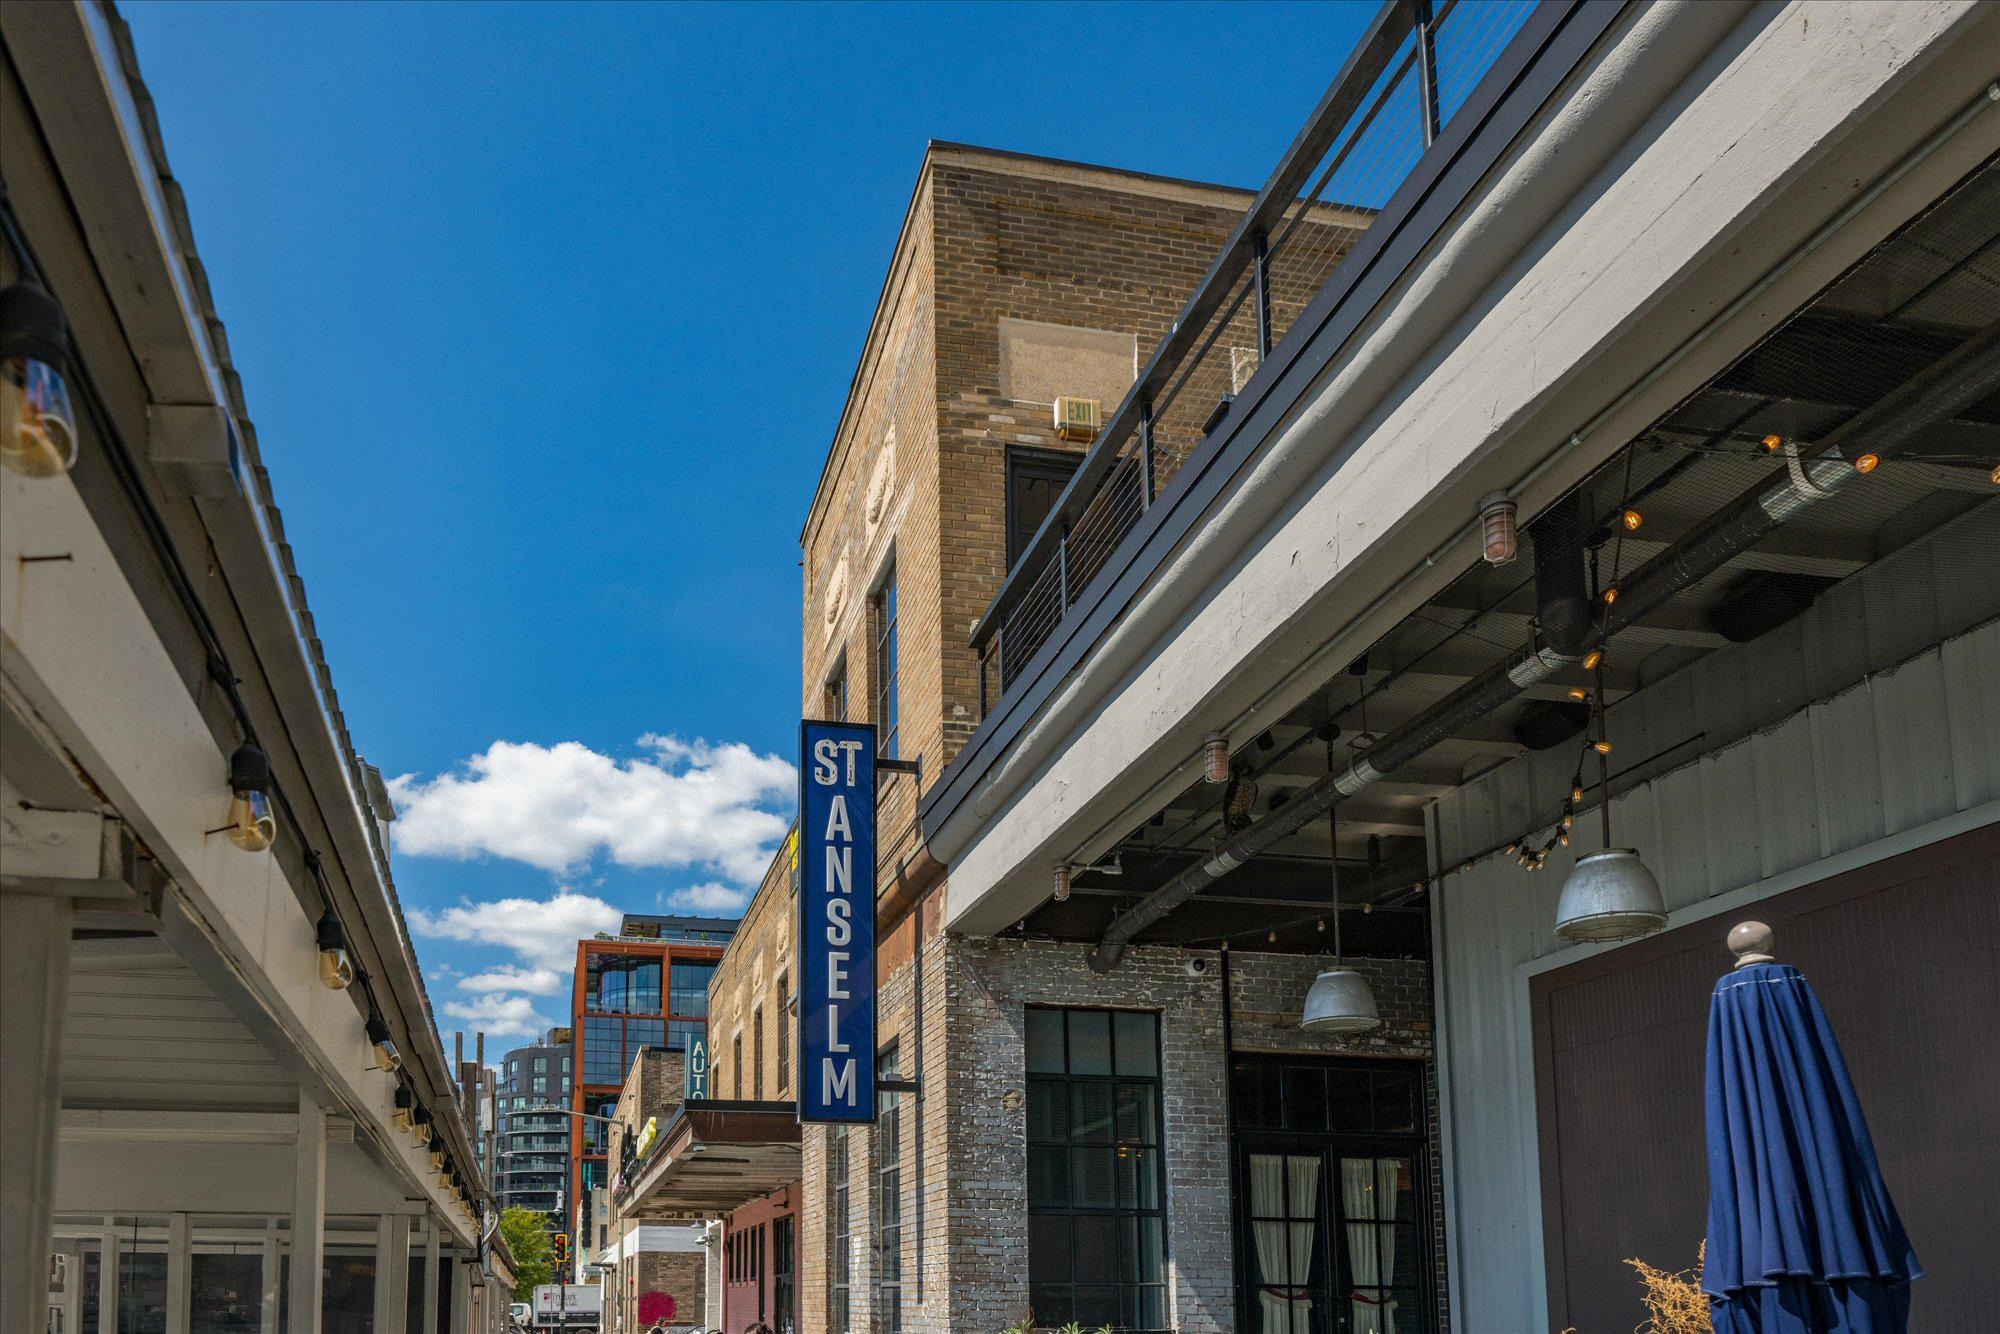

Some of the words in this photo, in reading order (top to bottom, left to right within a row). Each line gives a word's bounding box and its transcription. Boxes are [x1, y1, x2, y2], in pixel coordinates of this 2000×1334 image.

[1067, 400, 1091, 422] EXIT
[814, 739, 863, 787] ST
[822, 795, 857, 1107] ANSELM
